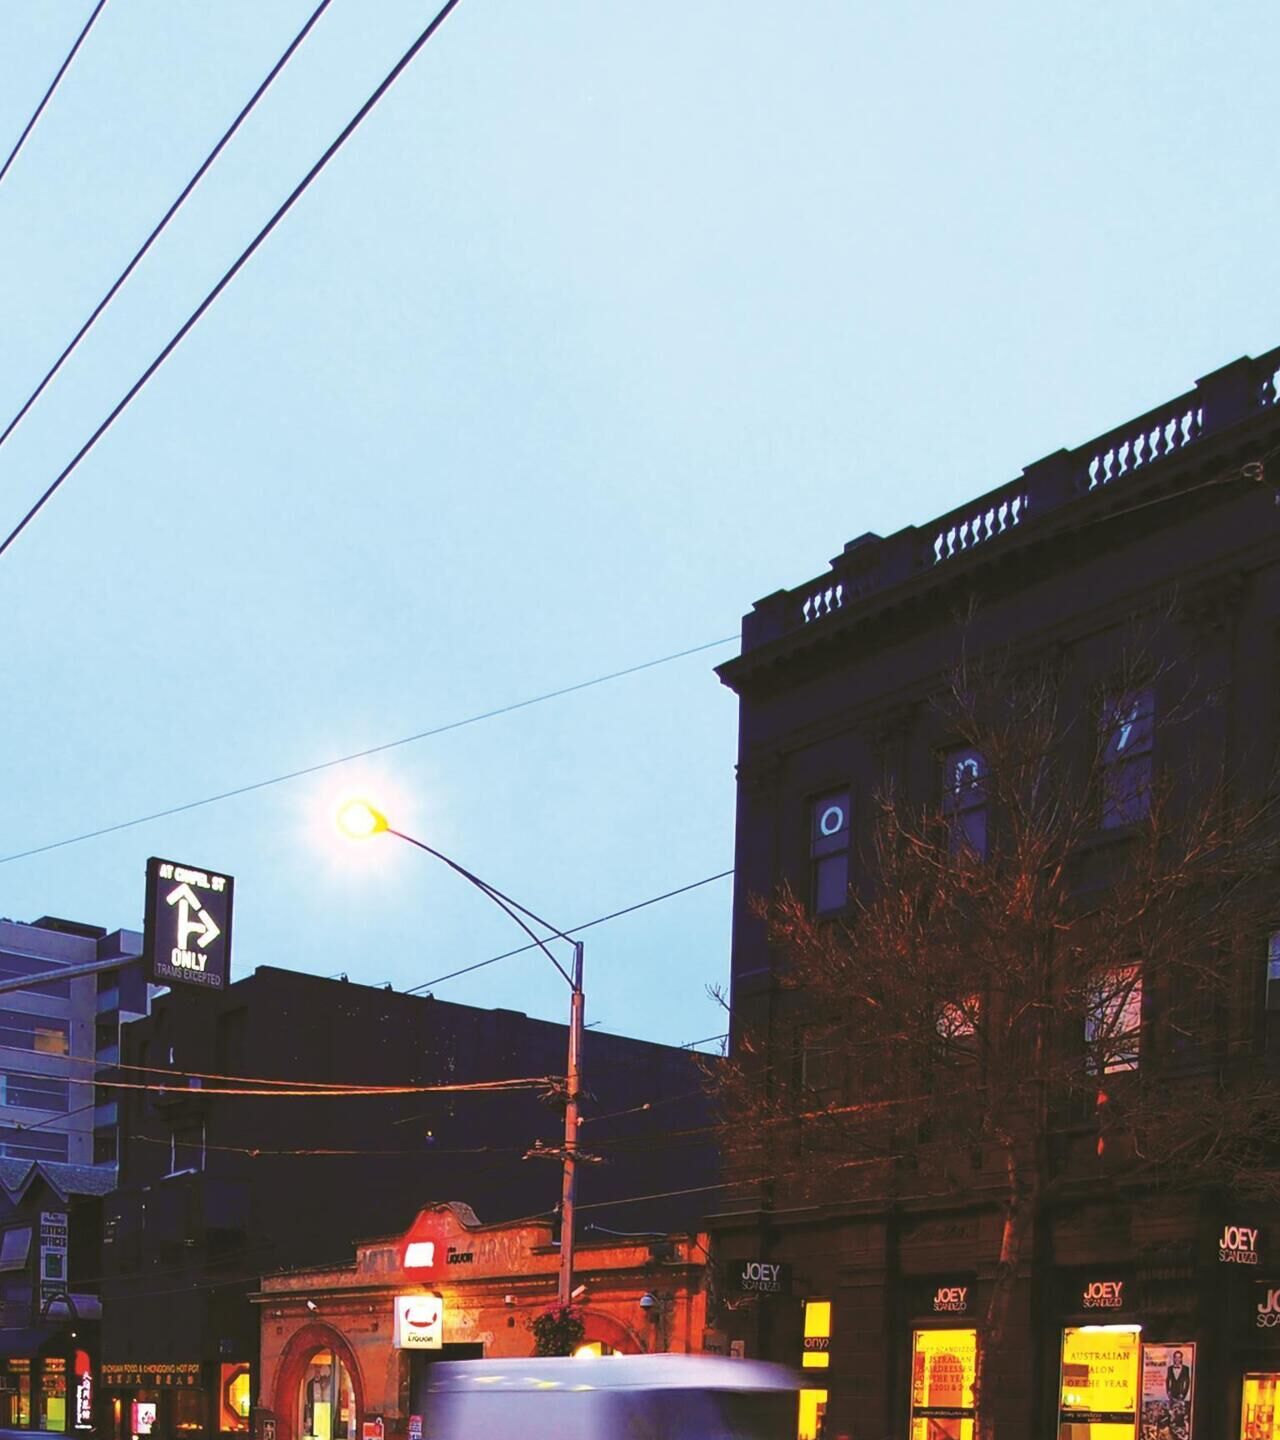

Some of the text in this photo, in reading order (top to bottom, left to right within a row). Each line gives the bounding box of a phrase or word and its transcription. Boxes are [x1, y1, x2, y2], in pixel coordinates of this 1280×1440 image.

[159, 864, 226, 892] AT CHAPEL ST
[171, 948, 207, 971] ONLY
[157, 963, 221, 986] TRAMS EXCEPTED
[1219, 1226, 1258, 1251] JOEY
[1219, 1249, 1258, 1264] SCANDIZZO
[742, 1262, 780, 1281] JOEY
[934, 1288, 967, 1302] JOEY
[1083, 1281, 1123, 1299] JOEY
[1071, 1352, 1130, 1361] AUSTRALIAN
[1104, 1379, 1129, 1387] YEAR
